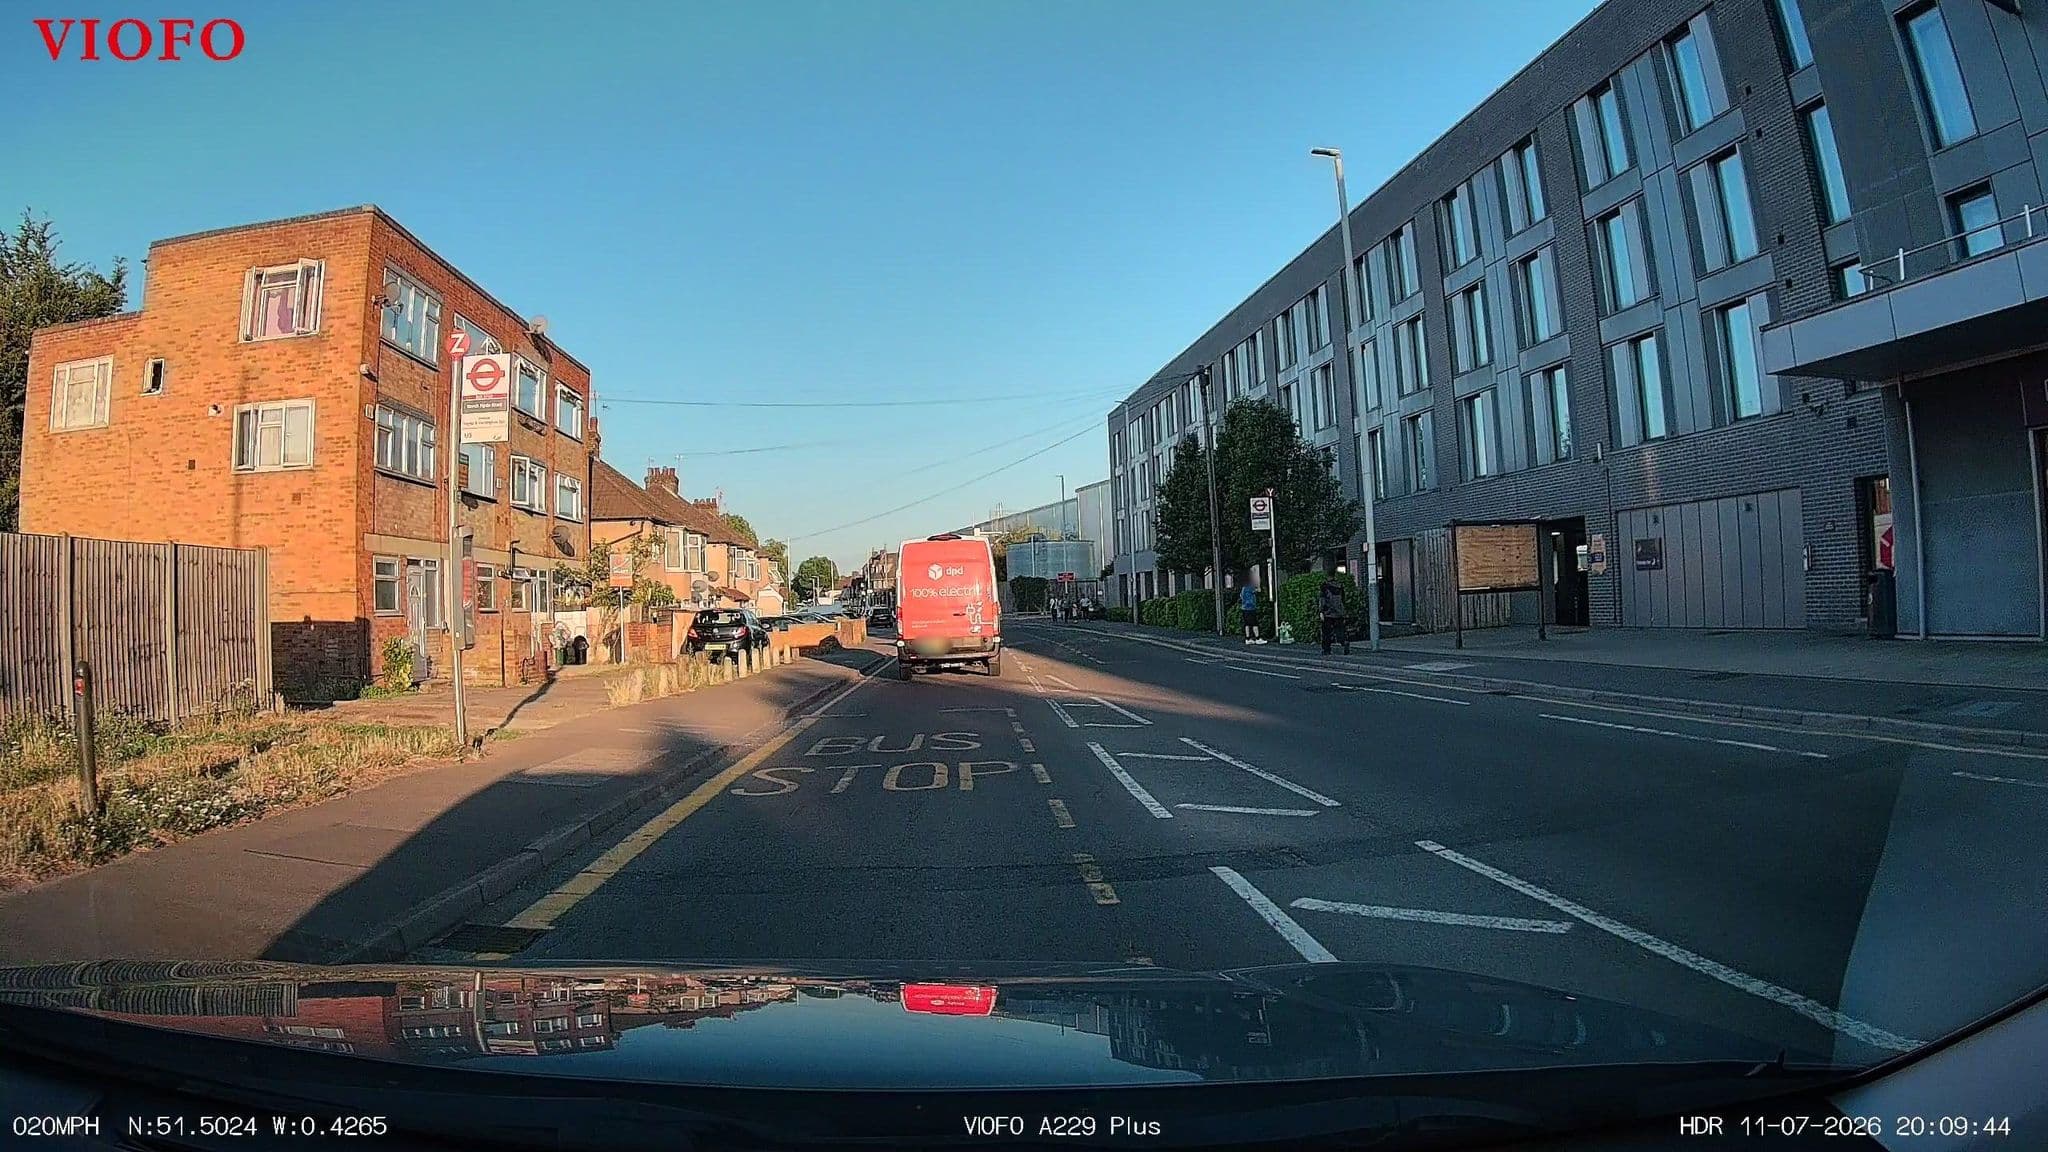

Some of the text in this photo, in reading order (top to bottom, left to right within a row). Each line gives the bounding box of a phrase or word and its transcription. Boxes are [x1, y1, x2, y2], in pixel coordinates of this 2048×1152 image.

[450, 333, 465, 353] Z
[945, 565, 964, 577] dpd
[912, 587, 938, 598] 100%
[804, 732, 980, 756] BUS
[731, 761, 1018, 796] STOP
